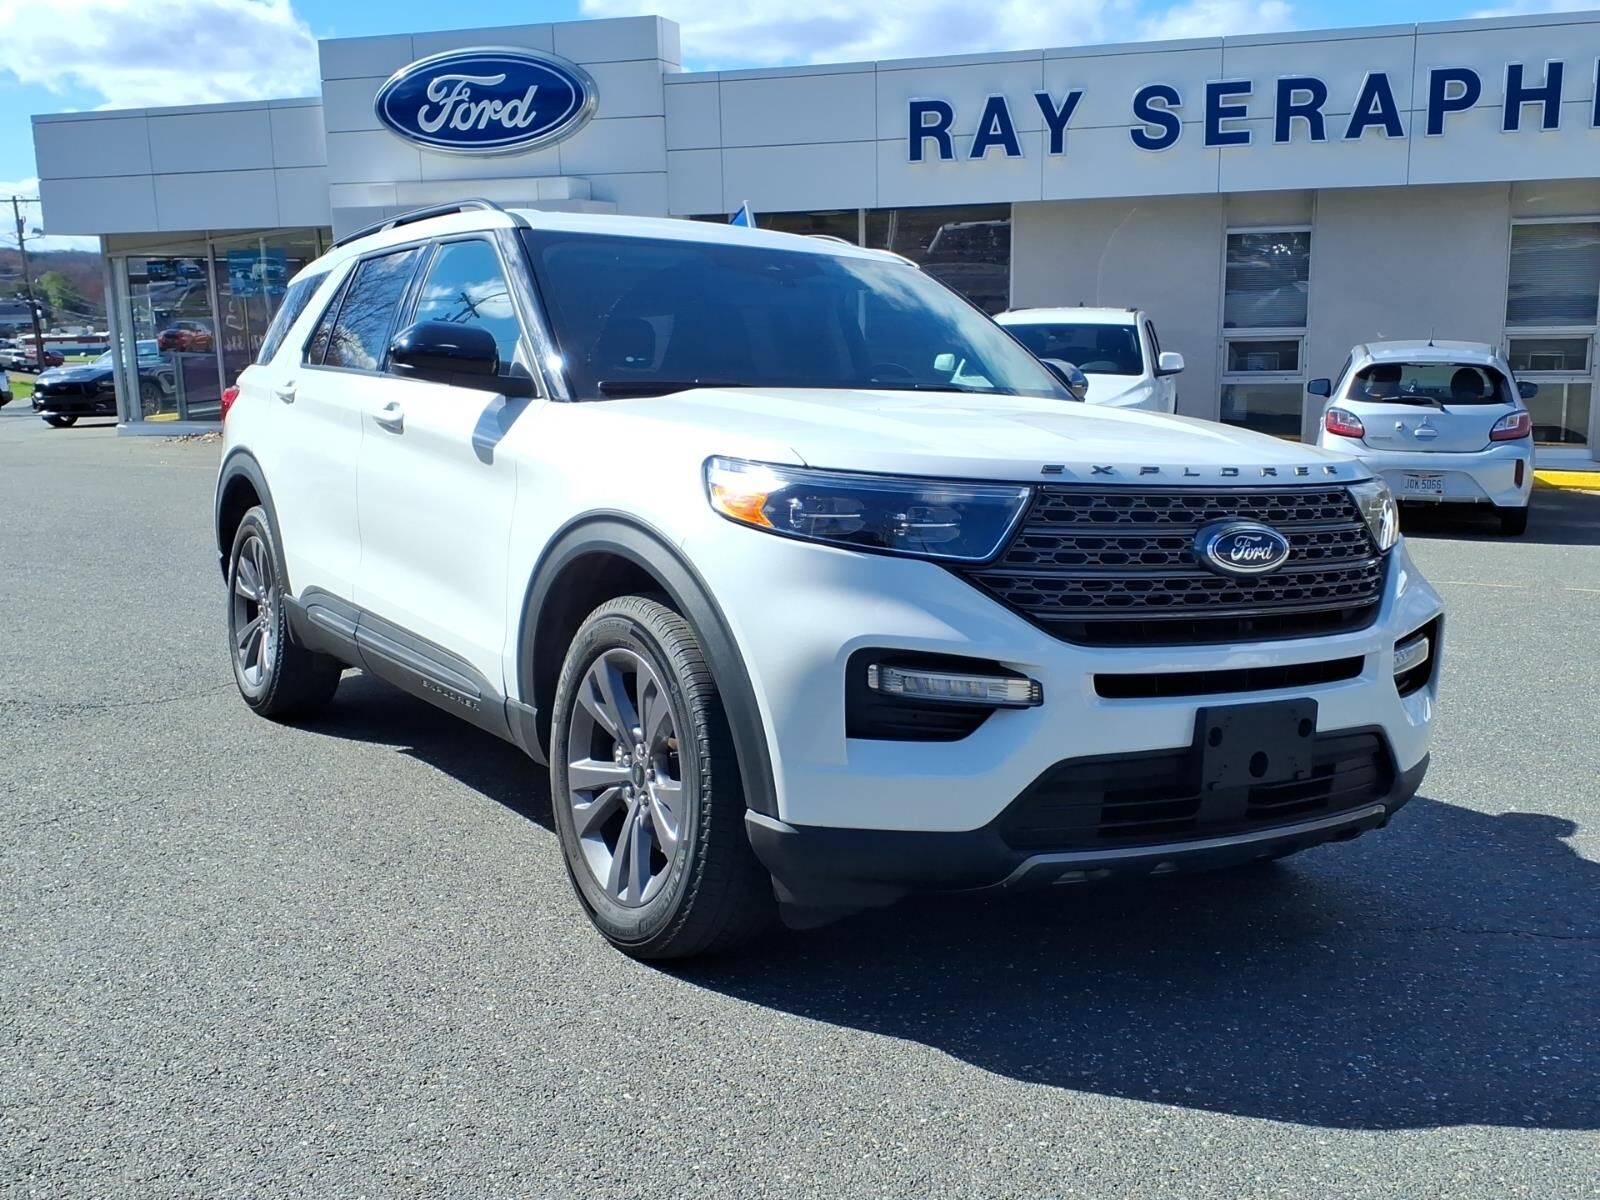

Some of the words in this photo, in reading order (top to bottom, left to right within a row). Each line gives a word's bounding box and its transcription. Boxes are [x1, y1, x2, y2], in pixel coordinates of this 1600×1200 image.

[417, 73, 539, 133] Ford
[908, 90, 1084, 162] RAY
[1040, 463, 1338, 477] EXPLORER
[1231, 535, 1274, 561] Ford
